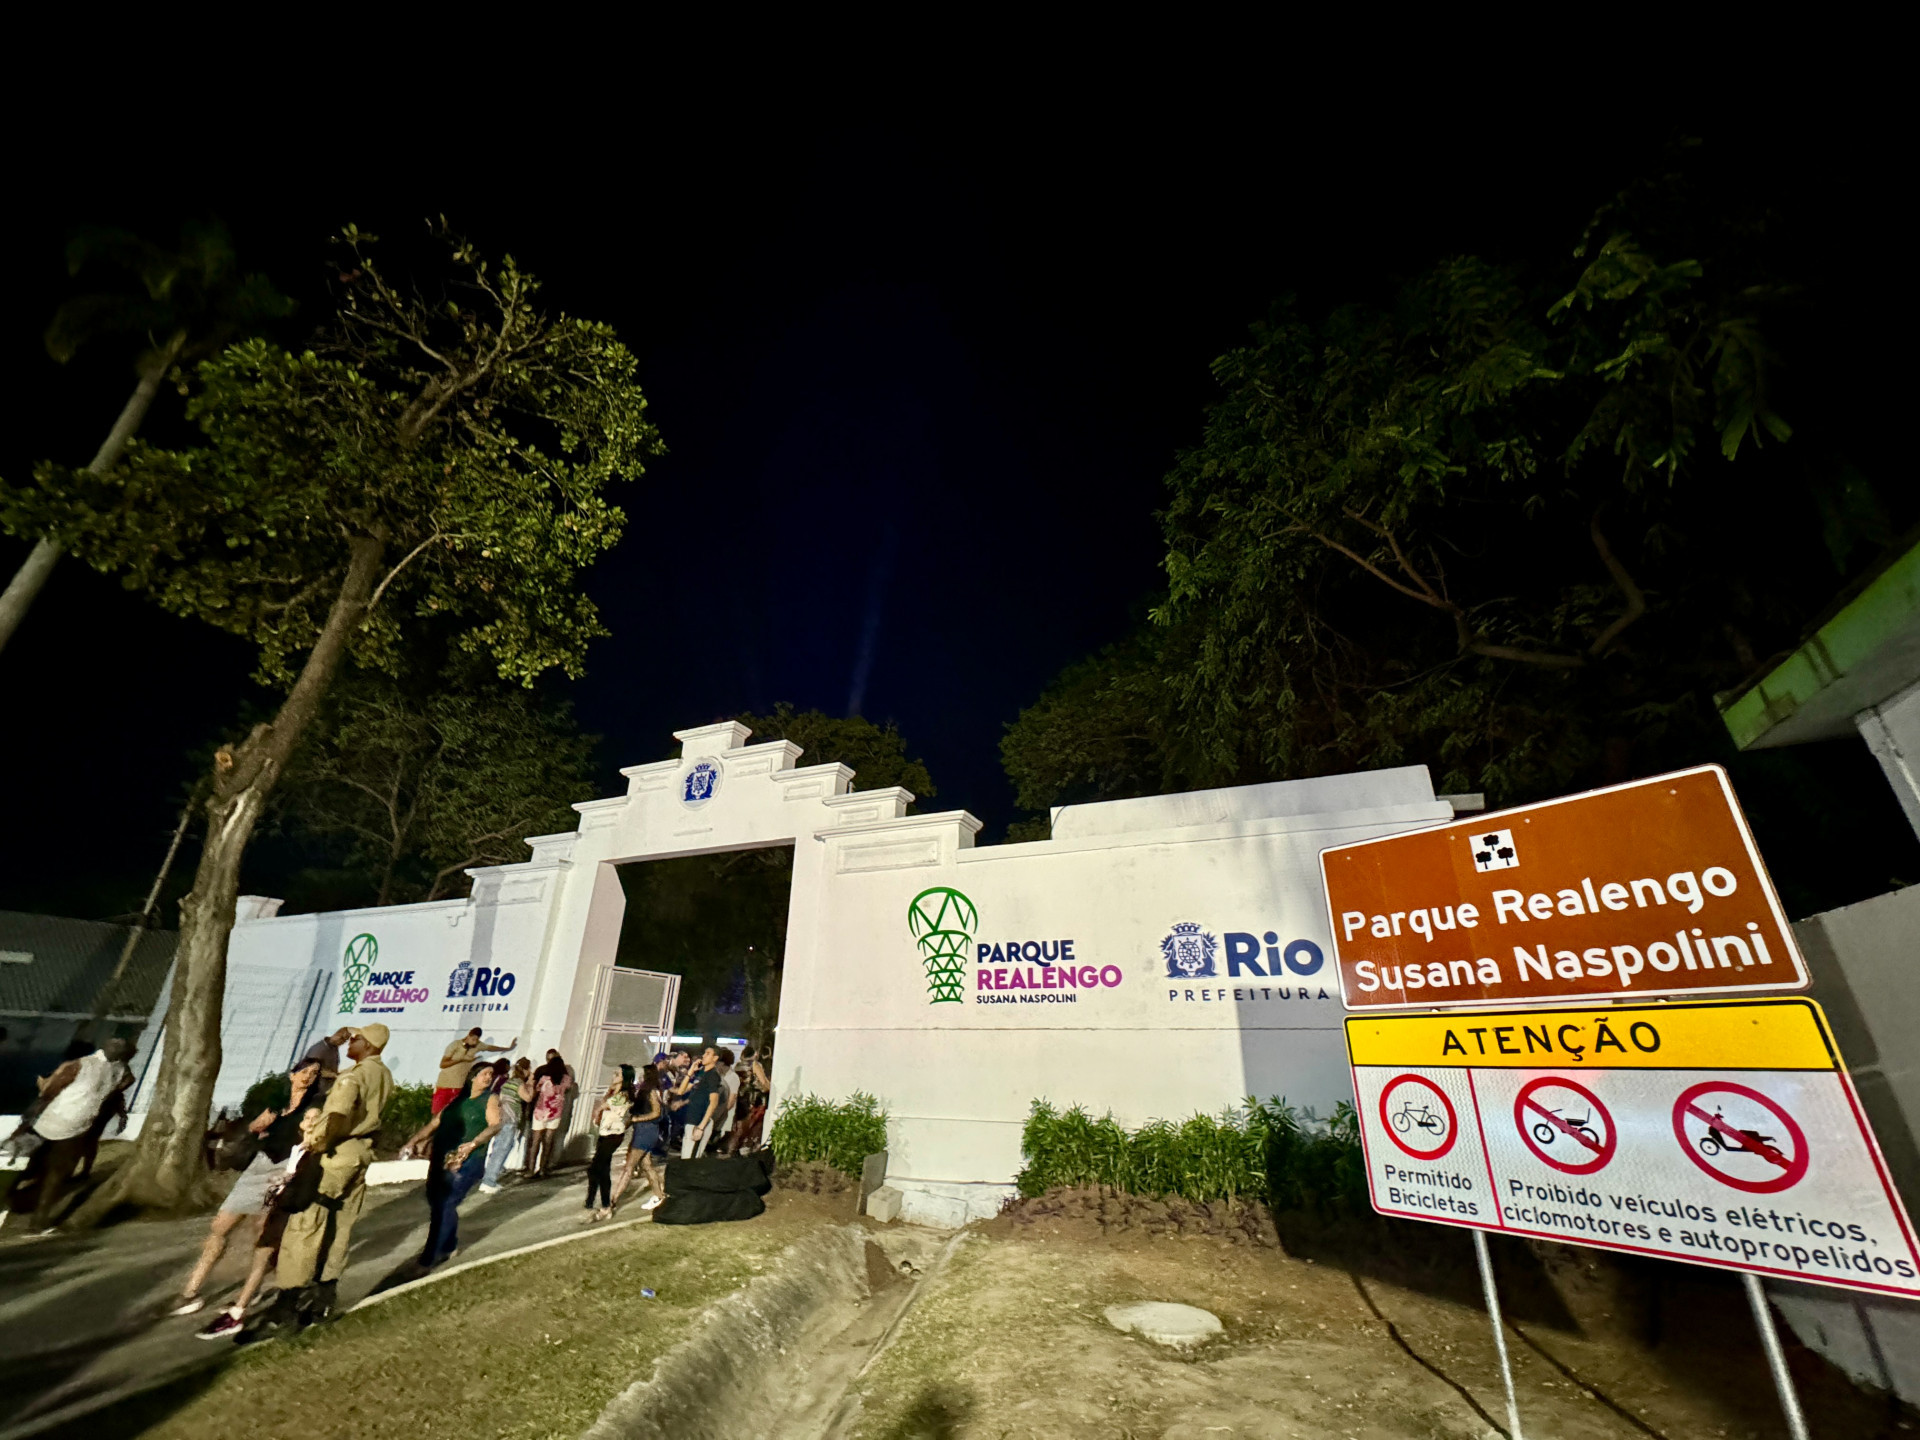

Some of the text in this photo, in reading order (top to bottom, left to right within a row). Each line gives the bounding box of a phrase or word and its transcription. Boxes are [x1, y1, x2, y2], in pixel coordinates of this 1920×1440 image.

[1342, 866, 1737, 943] Parque Realengo
[977, 939, 1075, 968] PARQUE
[1223, 931, 1325, 978] Rio
[1356, 922, 1772, 992] Susana Naspolini
[367, 970, 415, 989] PARQUE
[471, 967, 516, 996] Rio
[977, 965, 1123, 990] REALENGO
[362, 988, 429, 1004] REALENGO
[442, 1003, 509, 1012] PREFEITURA
[976, 994, 1077, 1004] SUSANA NASPOLINI
[1169, 987, 1330, 1002] PREFEITURA
[1441, 1017, 1662, 1062] ATENÇÃO
[1385, 1164, 1473, 1192] Permitido
[1389, 1187, 1479, 1216] Bicicletas
[1508, 1178, 1880, 1246] Proibido veículos elétricos,
[1503, 1203, 1917, 1280] ciclomotores e autopropelidos
